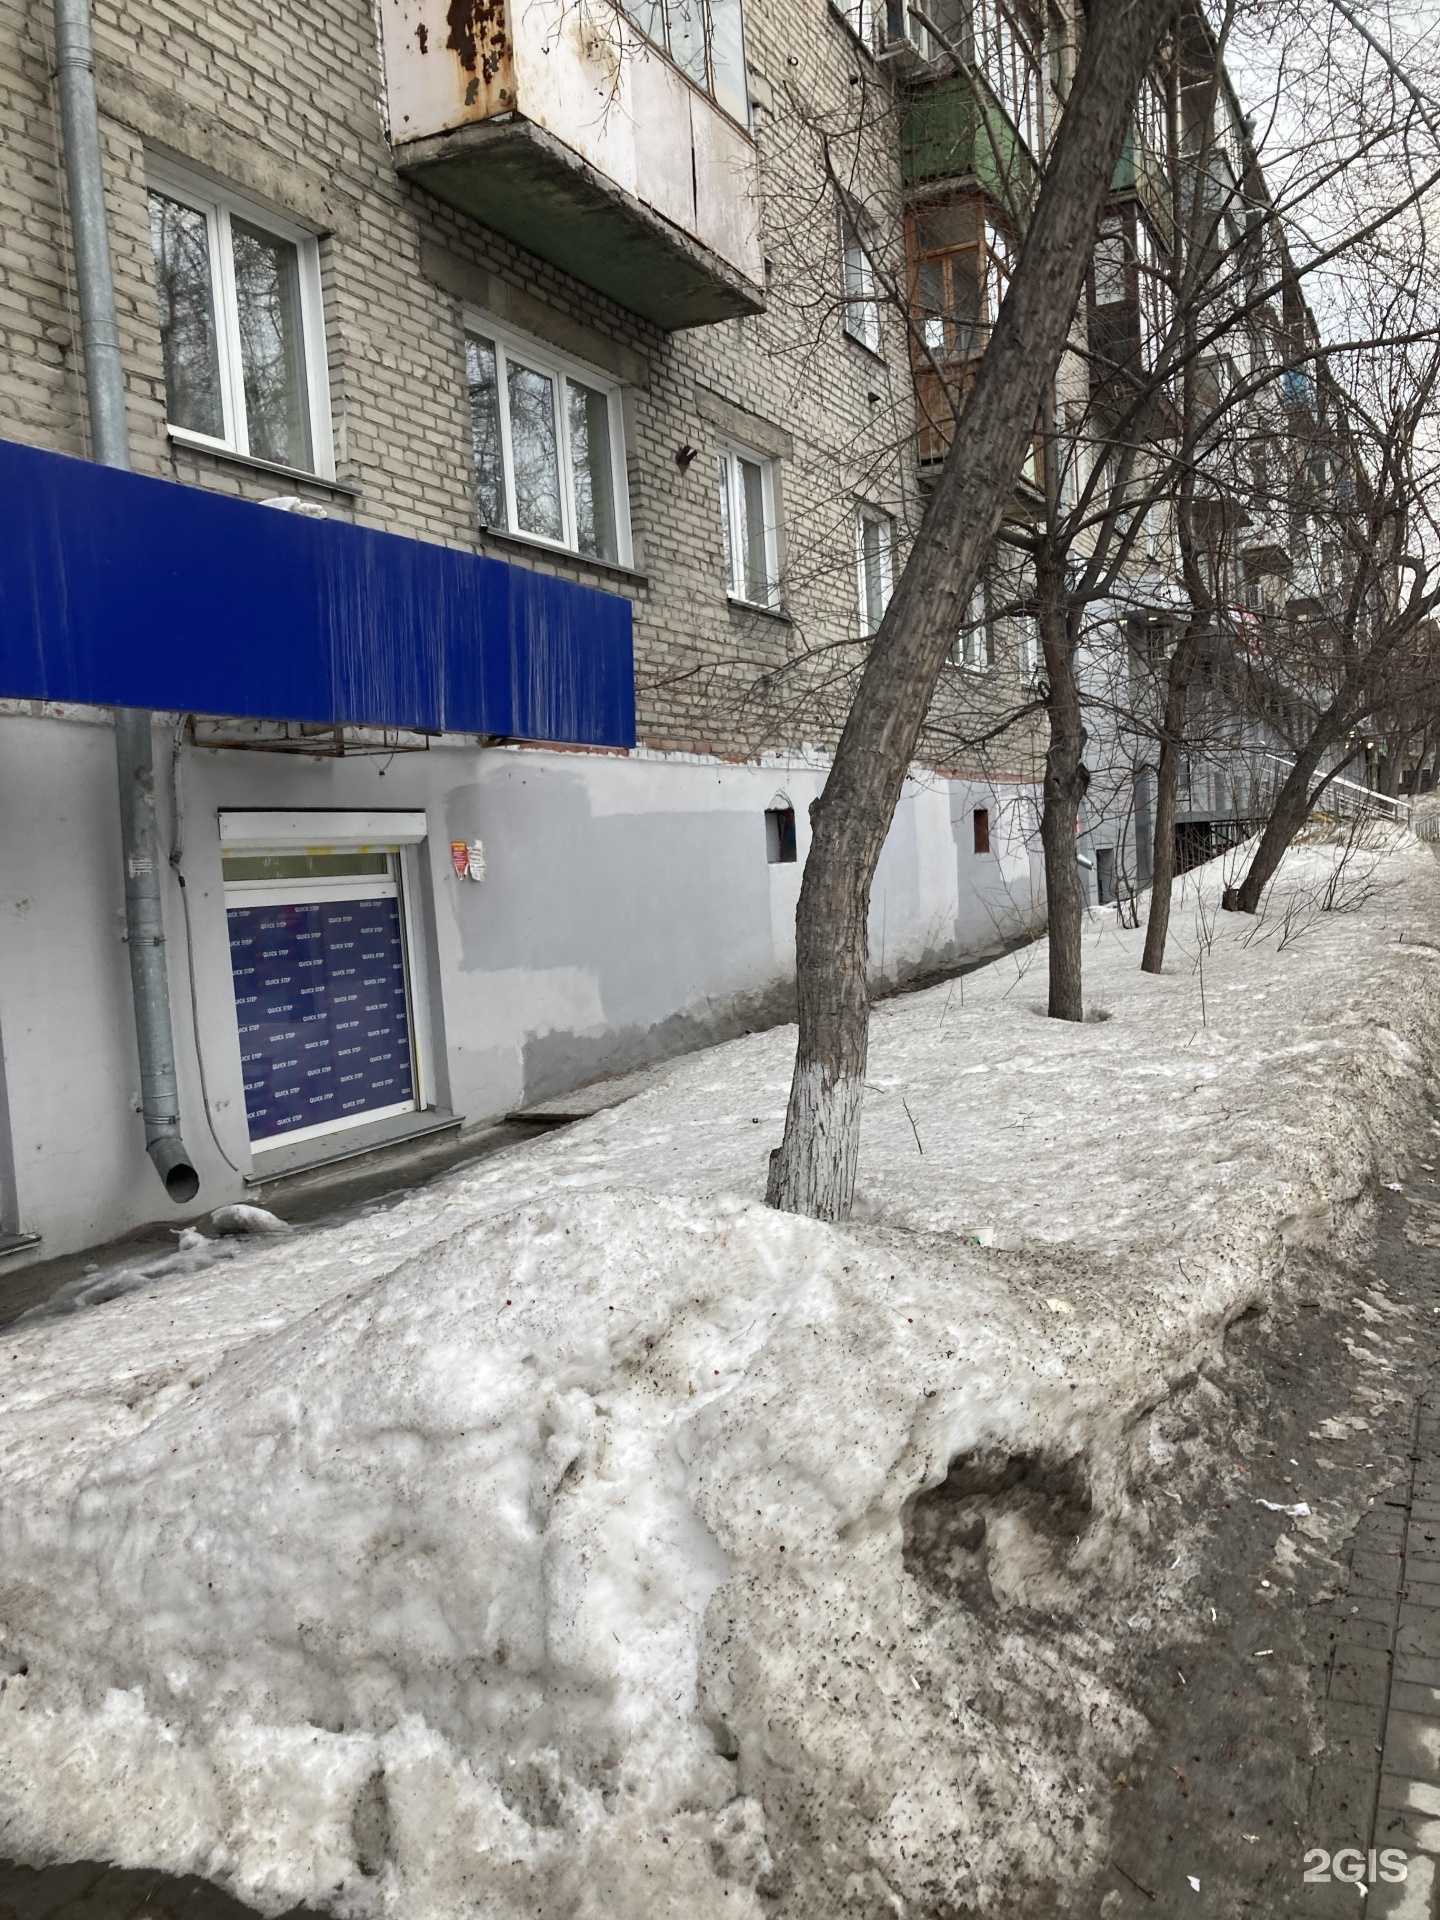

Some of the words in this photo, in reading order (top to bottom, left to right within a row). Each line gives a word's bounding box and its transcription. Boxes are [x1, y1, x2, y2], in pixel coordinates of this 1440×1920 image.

[265, 978, 280, 986] QUICK
[267, 1006, 282, 1014] QUICK
[270, 1034, 284, 1042] QUICK
[272, 1062, 286, 1070] QUICK
[275, 1090, 289, 1098] QUICK
[343, 1101, 355, 1109] QUICK
[277, 1118, 291, 1126] QUICK
